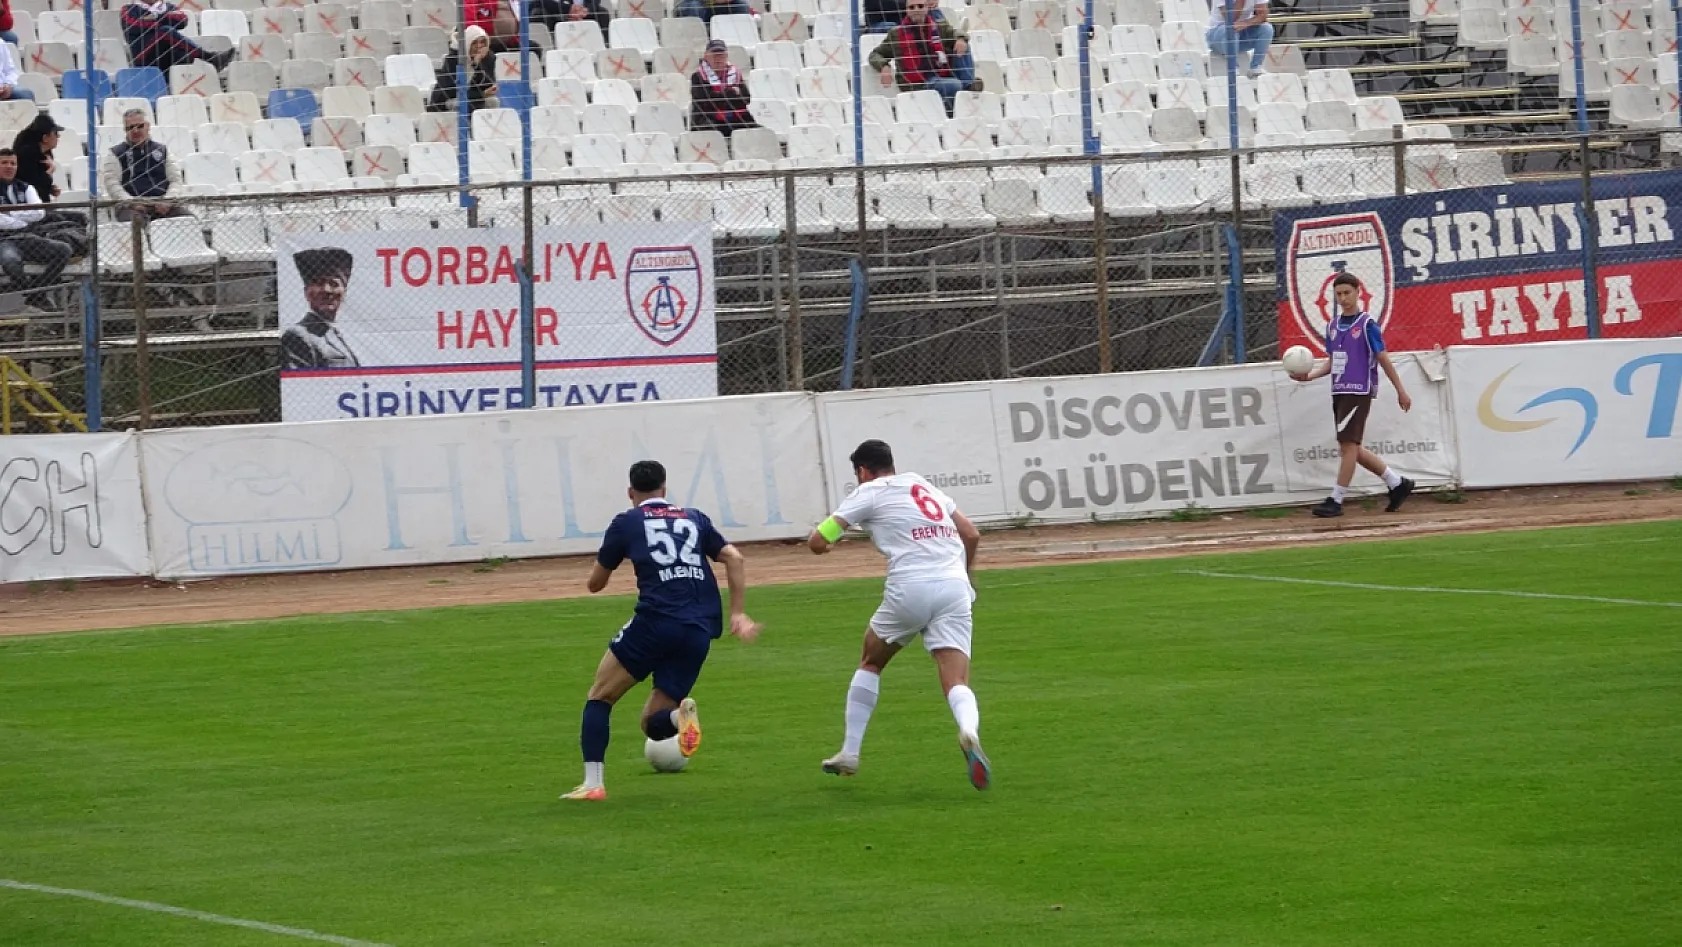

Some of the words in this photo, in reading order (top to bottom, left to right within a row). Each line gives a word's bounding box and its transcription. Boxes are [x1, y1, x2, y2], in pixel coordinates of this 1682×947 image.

[1302, 229, 1373, 251] ALTINORDU
[437, 307, 560, 350] HAYR
[1018, 441, 1275, 511] ÖLÜDENİZ
[910, 483, 944, 522] 6
[643, 518, 702, 567] 52
